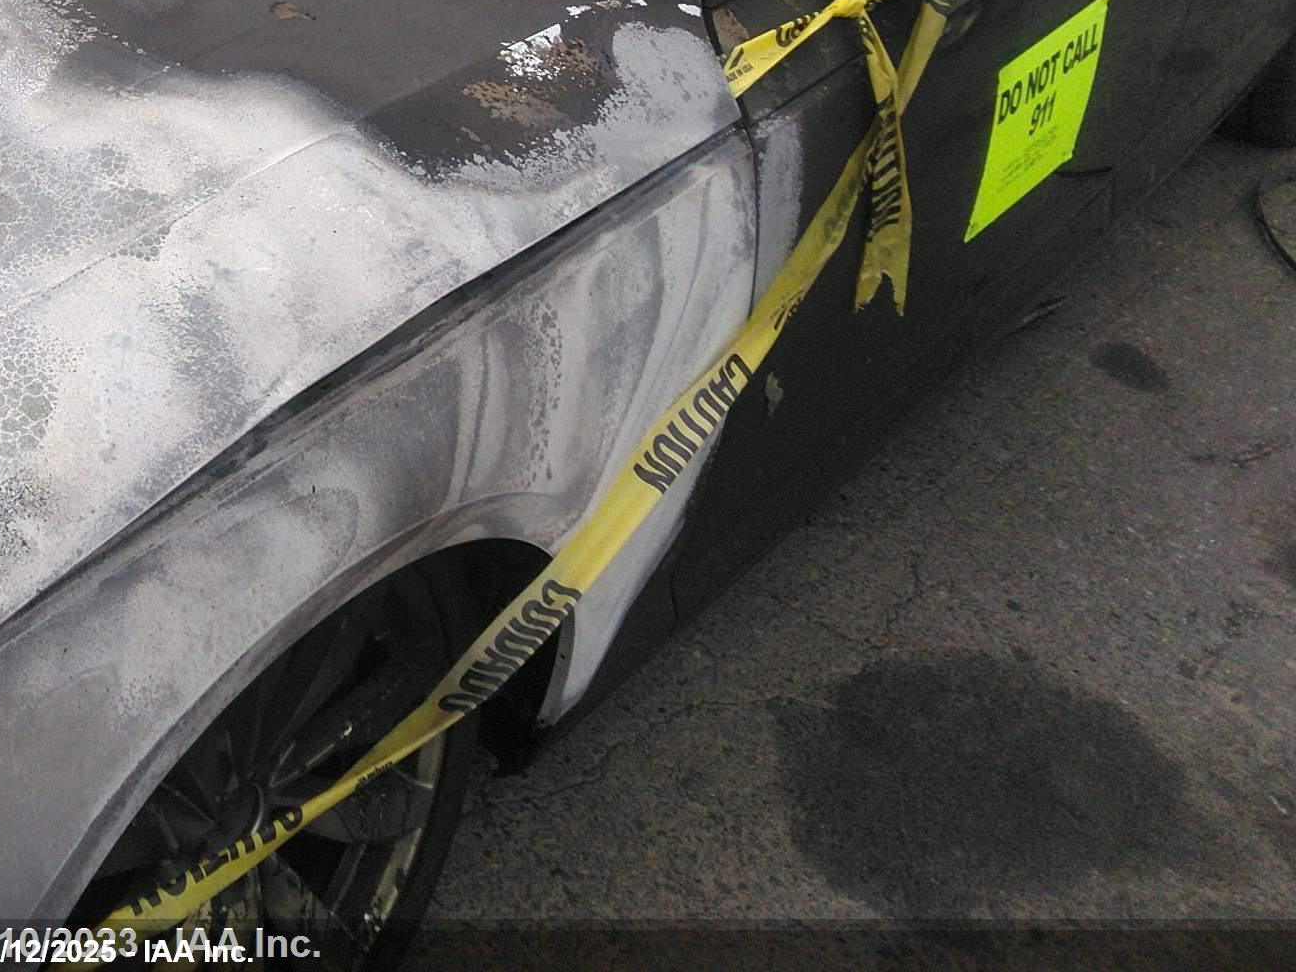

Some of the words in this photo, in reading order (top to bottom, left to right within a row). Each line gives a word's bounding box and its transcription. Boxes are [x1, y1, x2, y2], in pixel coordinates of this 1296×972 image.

[997, 81, 1023, 125] DO
[1025, 50, 1061, 105] NOT
[1062, 23, 1098, 74] CALL
[1028, 91, 1057, 137] 911
[633, 353, 754, 494] CAUTION
[438, 579, 583, 715] CUIDADO
